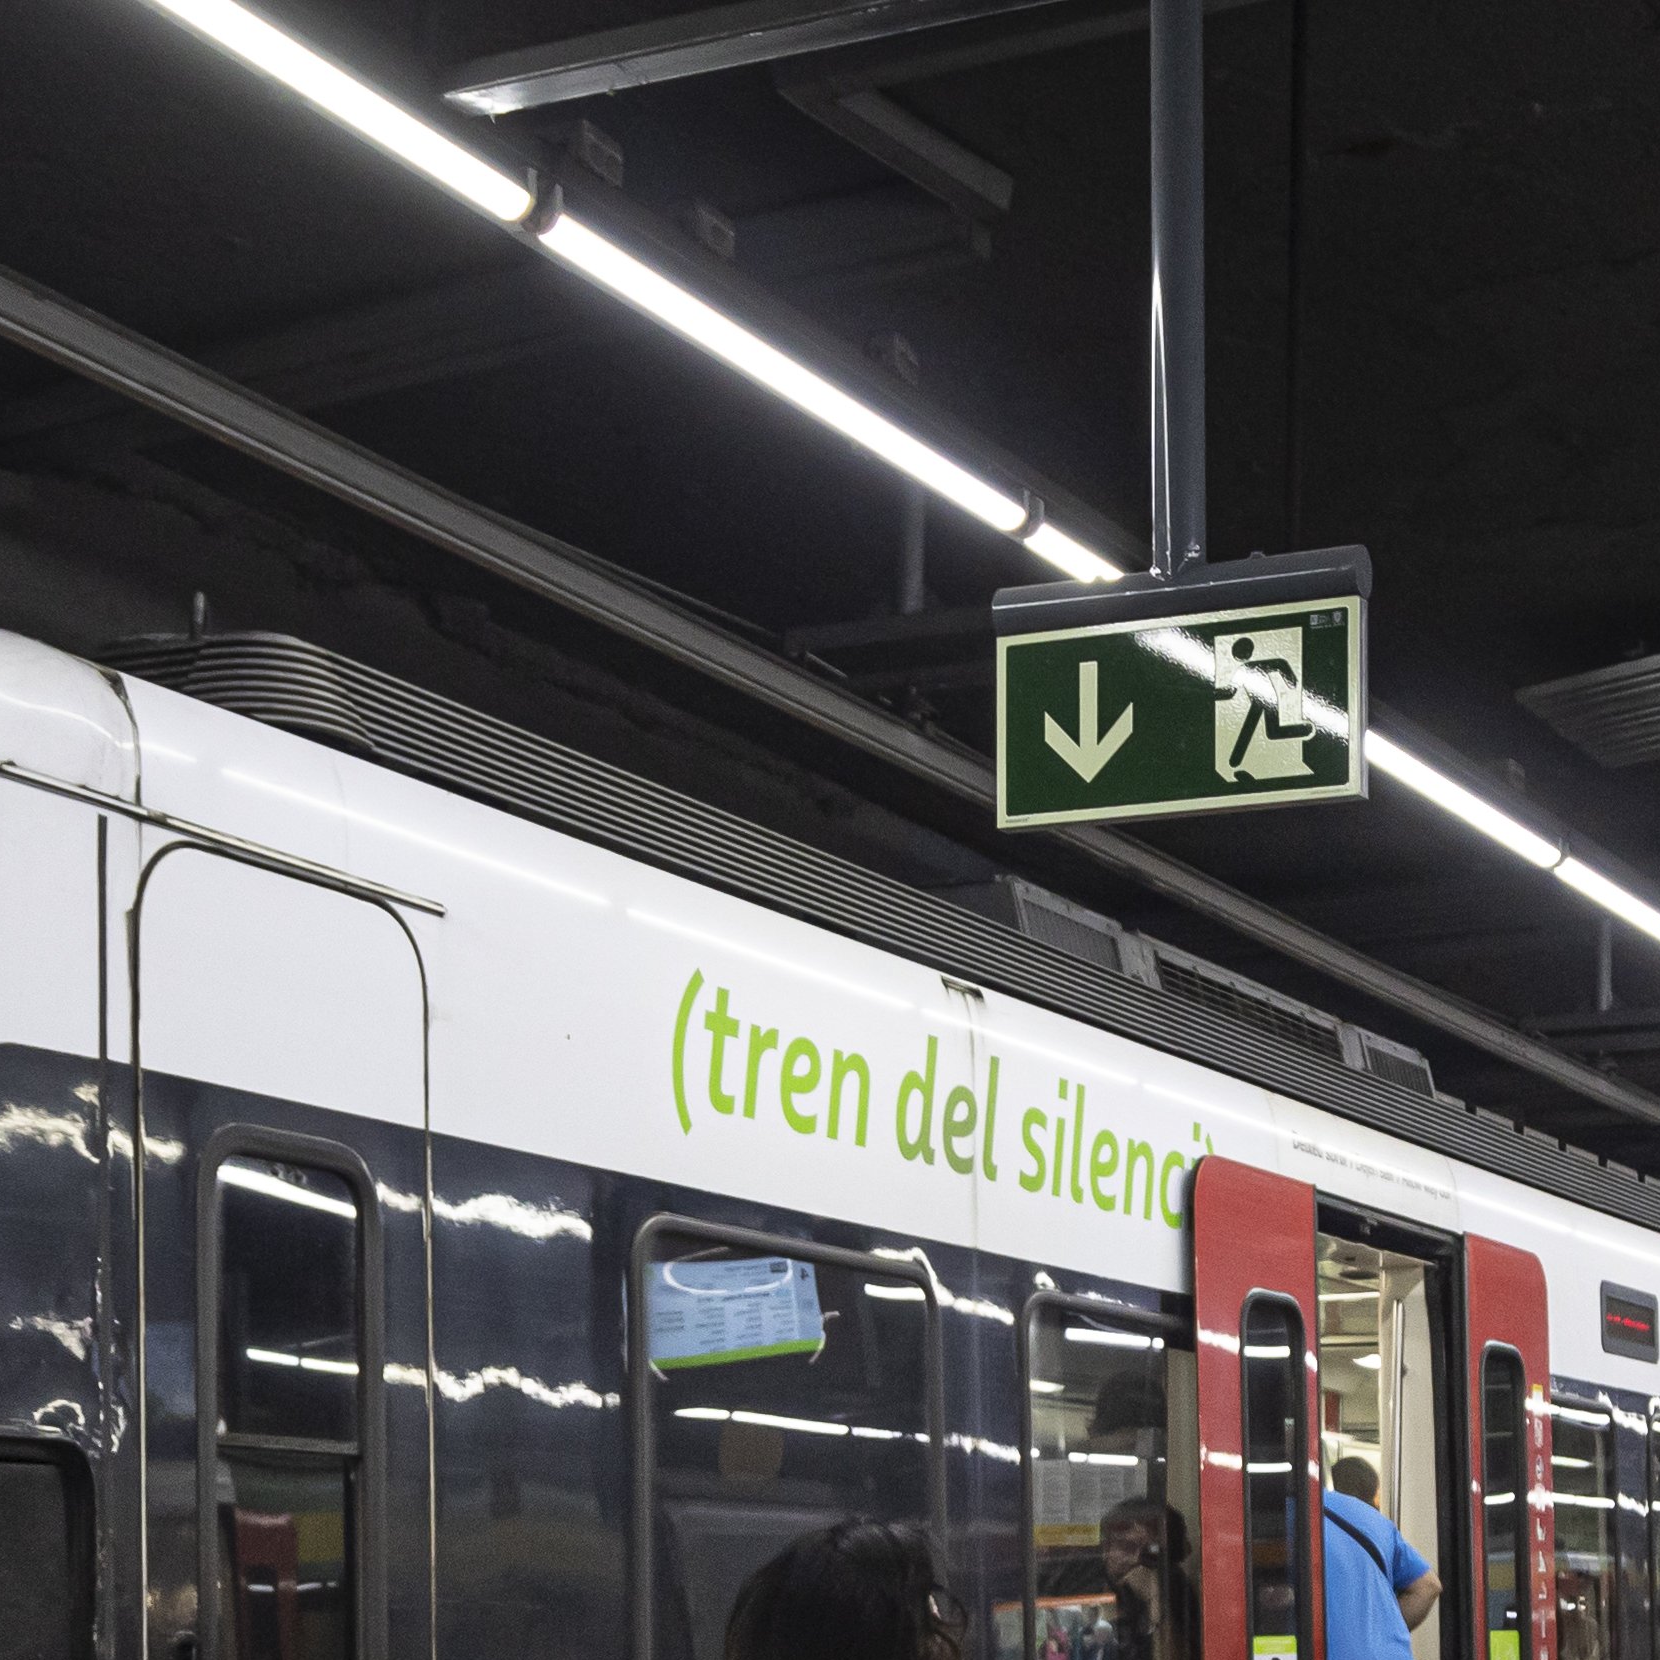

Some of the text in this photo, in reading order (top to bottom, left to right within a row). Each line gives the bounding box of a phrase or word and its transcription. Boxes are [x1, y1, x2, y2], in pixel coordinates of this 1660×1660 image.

[672, 968, 871, 1148] (tren
[896, 1034, 999, 1182] del
[1018, 1077, 1214, 1230] silenc
